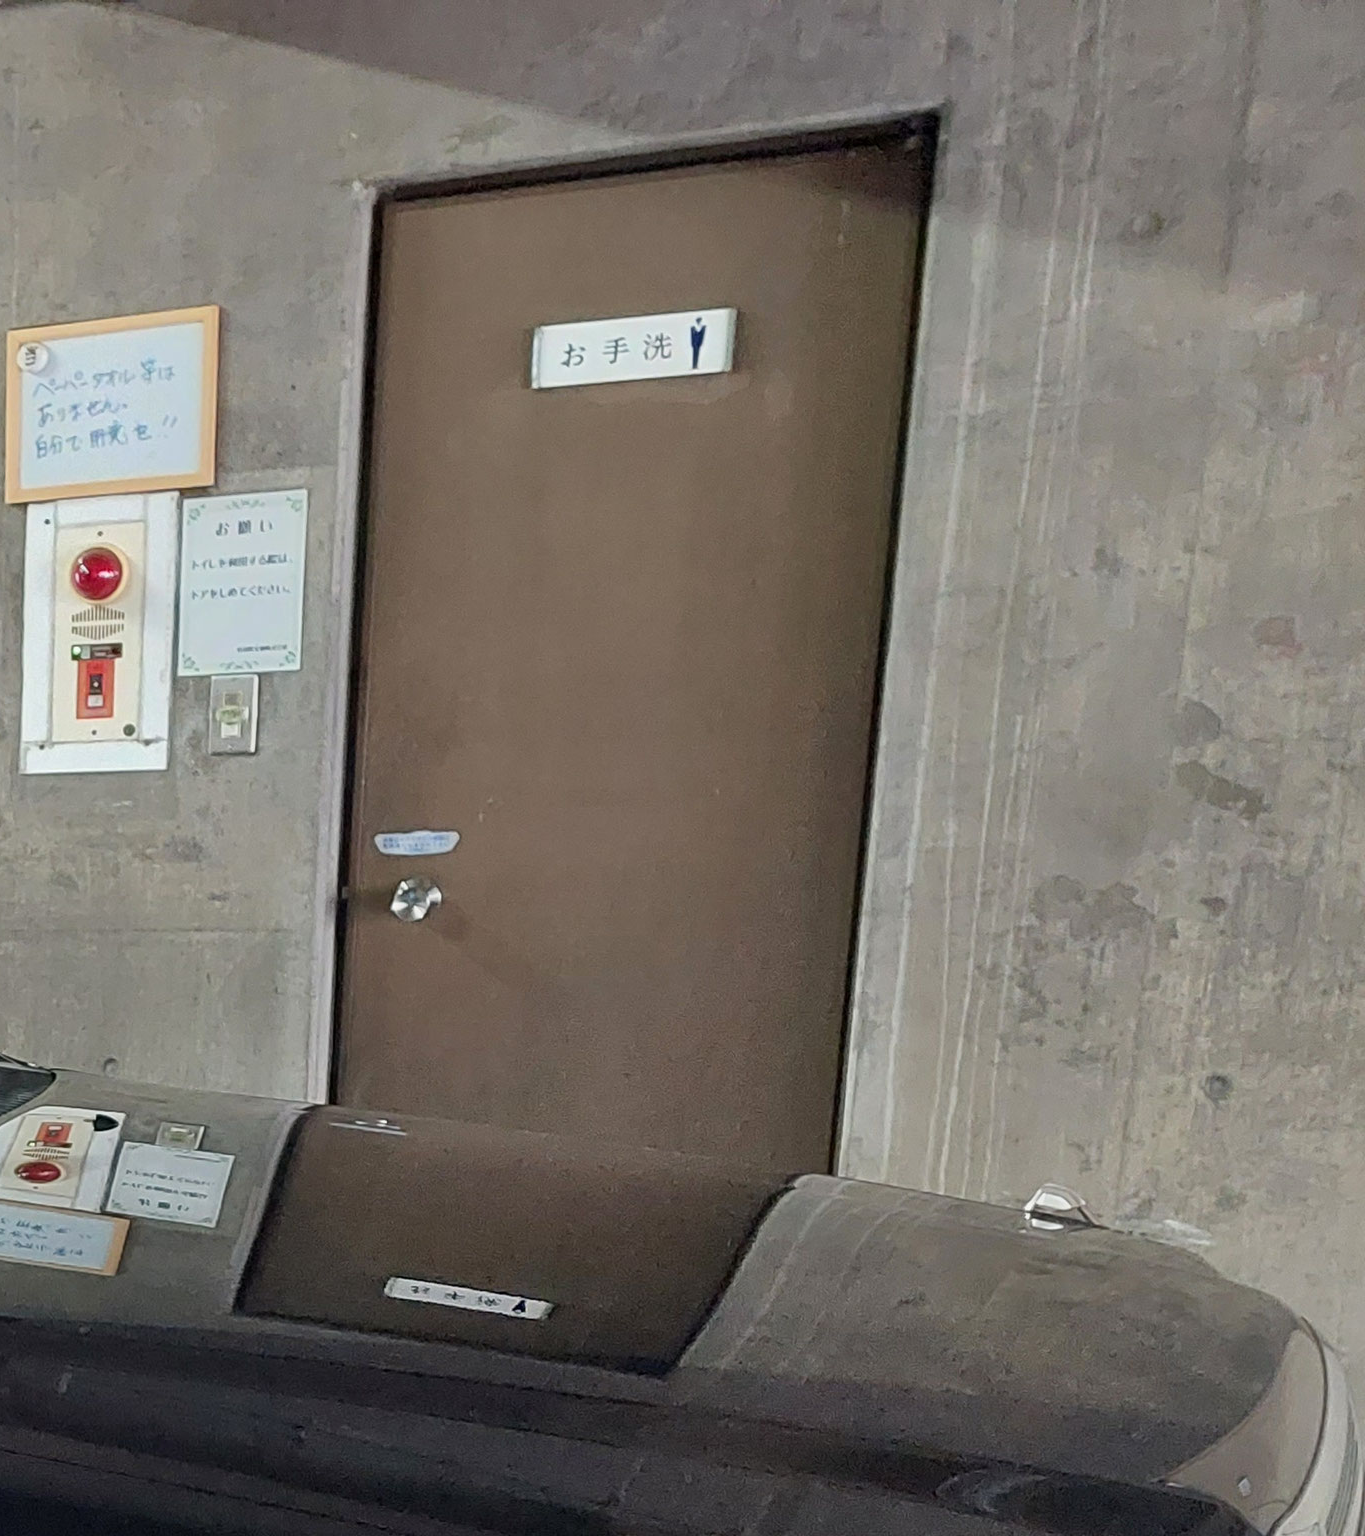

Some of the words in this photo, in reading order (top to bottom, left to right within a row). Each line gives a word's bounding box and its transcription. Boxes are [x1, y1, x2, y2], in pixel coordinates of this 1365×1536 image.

[560, 332, 673, 368] お手洗
[215, 519, 274, 536] お願い
